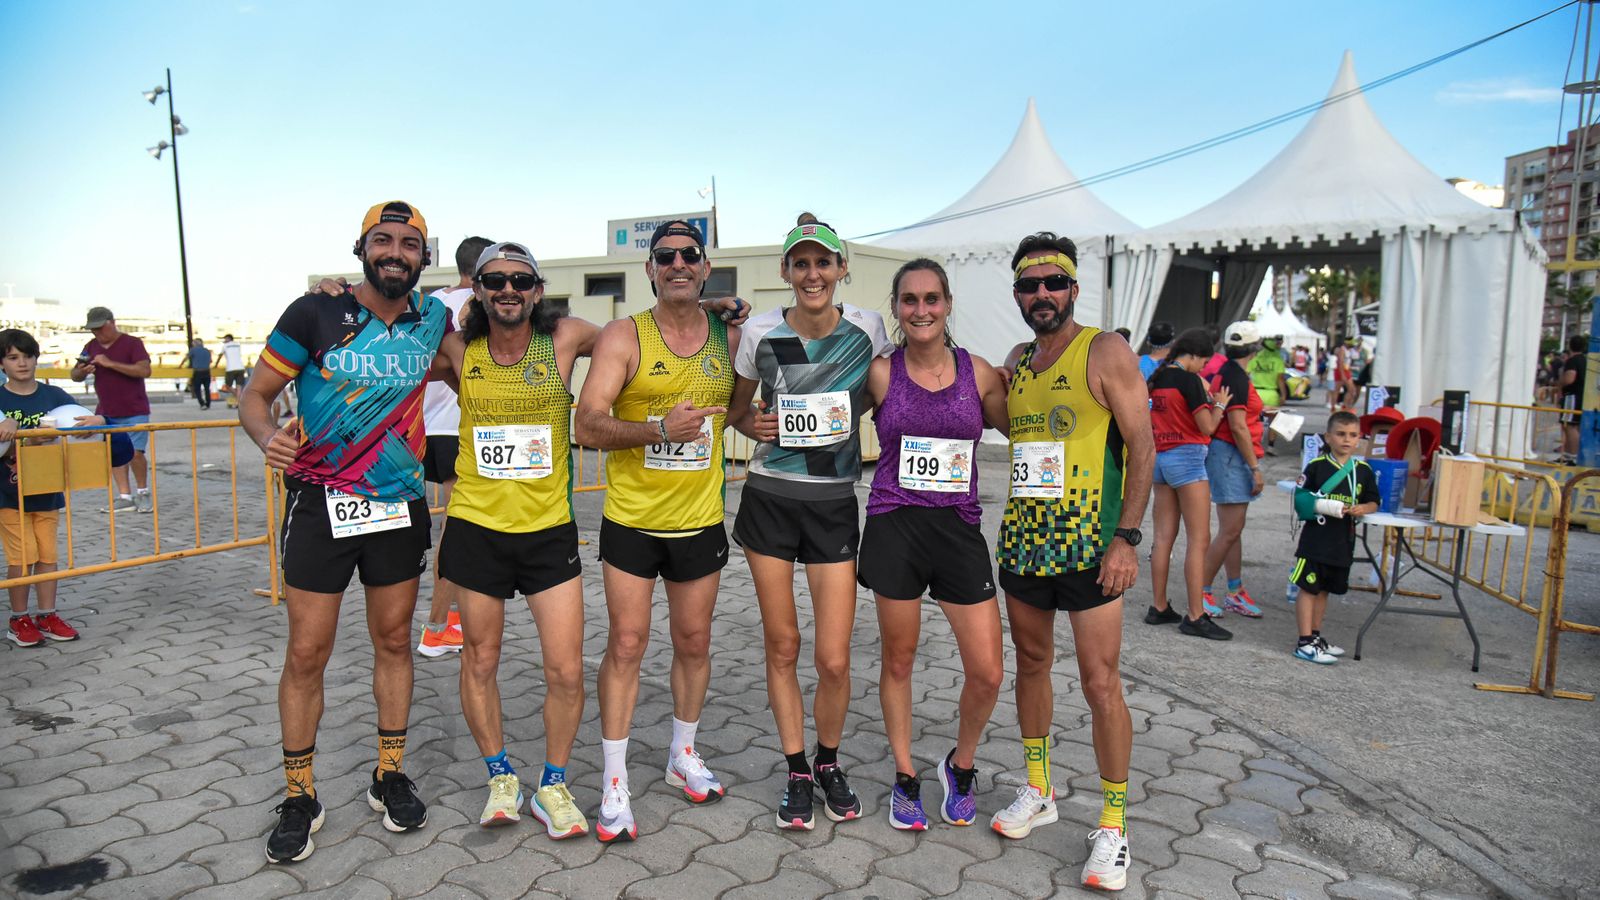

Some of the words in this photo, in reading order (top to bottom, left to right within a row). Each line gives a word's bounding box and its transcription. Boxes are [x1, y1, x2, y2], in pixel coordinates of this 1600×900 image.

[355, 379, 390, 387] TRAIL
[781, 400, 793, 408] XXI
[785, 413, 817, 432] 600
[477, 431, 491, 440] XXI
[904, 440, 918, 449] XXI
[481, 445, 515, 464] 687
[906, 455, 939, 476] 199
[1012, 462, 1028, 482] 53
[335, 500, 371, 521] 623
